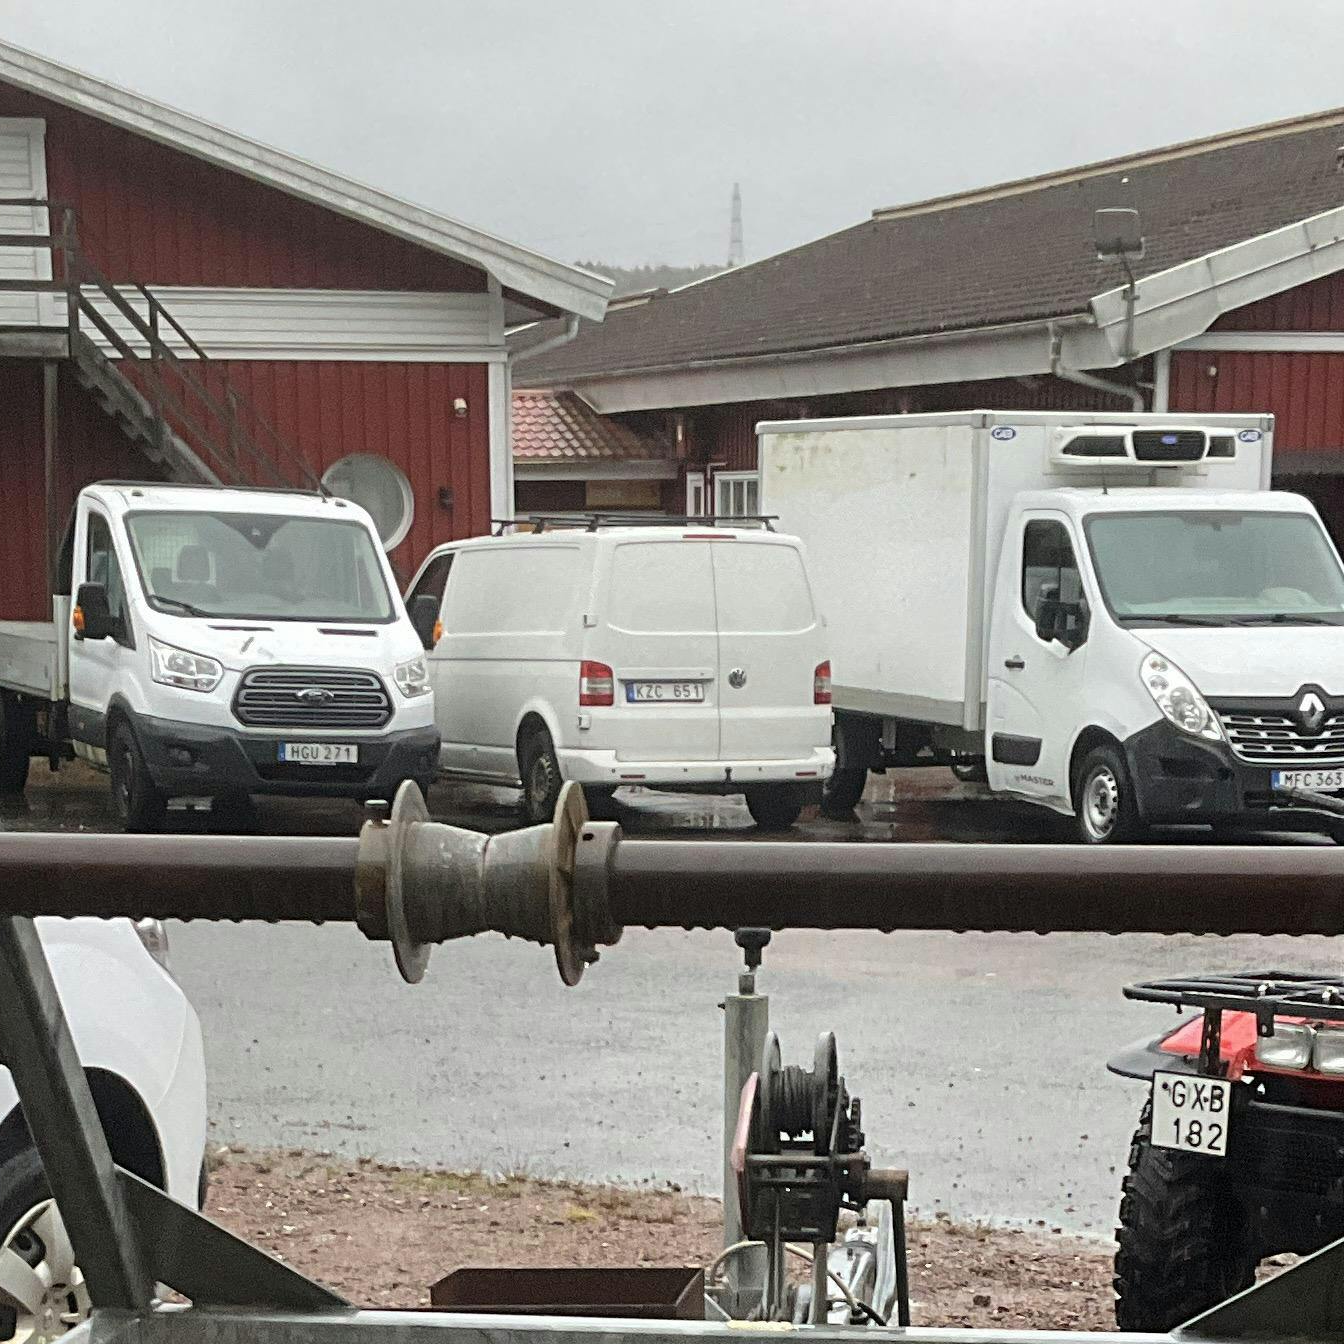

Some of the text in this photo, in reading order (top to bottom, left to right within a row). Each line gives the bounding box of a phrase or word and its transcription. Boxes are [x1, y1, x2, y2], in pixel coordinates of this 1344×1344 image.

[636, 684, 700, 698] KZC 651
[291, 745, 350, 761] HGU 271
[1284, 771, 1343, 787] MFC 363
[1172, 1080, 1225, 1113] GXB
[1173, 1117, 1223, 1151] 182
